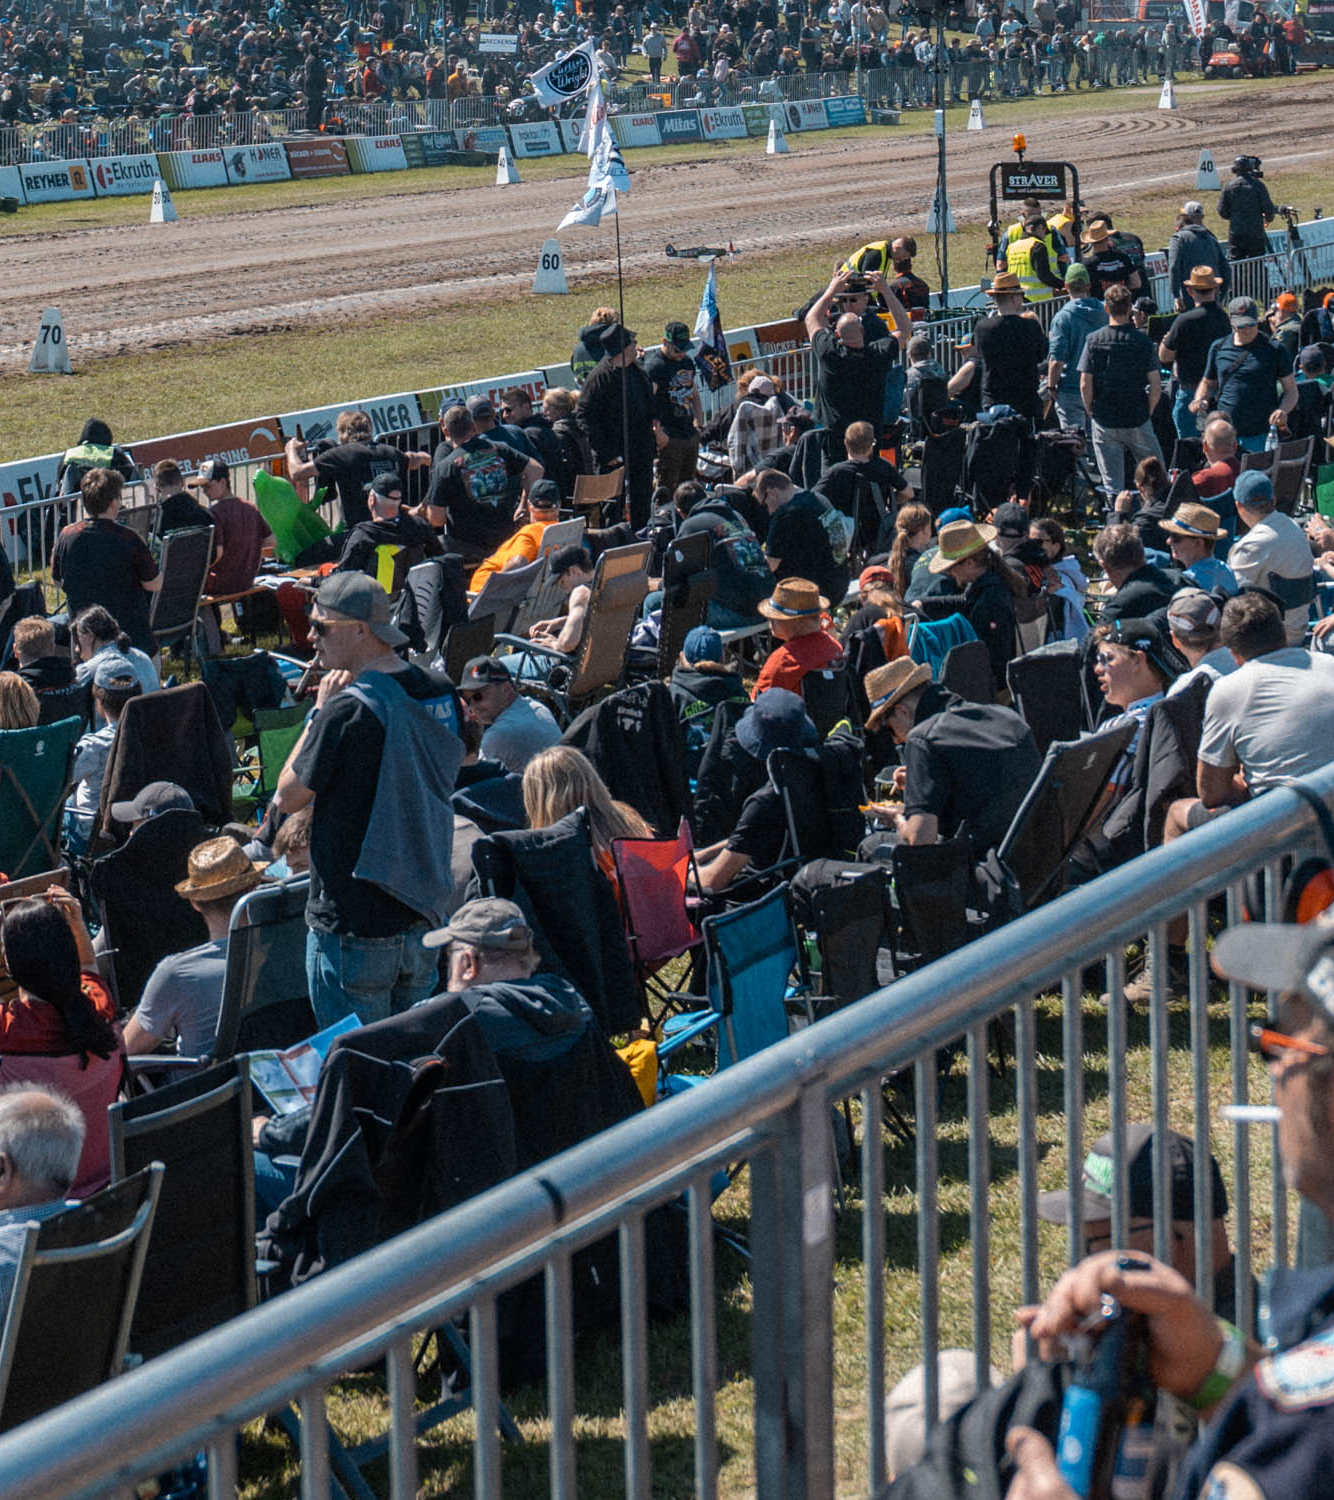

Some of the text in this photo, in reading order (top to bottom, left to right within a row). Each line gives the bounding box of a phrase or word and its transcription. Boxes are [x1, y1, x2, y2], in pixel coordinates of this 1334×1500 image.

[375, 138, 401, 149] CLAAS
[191, 152, 222, 164] CLAAS
[1200, 160, 1213, 173] 40
[25, 173, 69, 190] REYHER
[1009, 173, 1059, 186] STRAVER
[542, 252, 560, 270] 60
[41, 323, 62, 346] 70
[370, 402, 412, 434] NER
